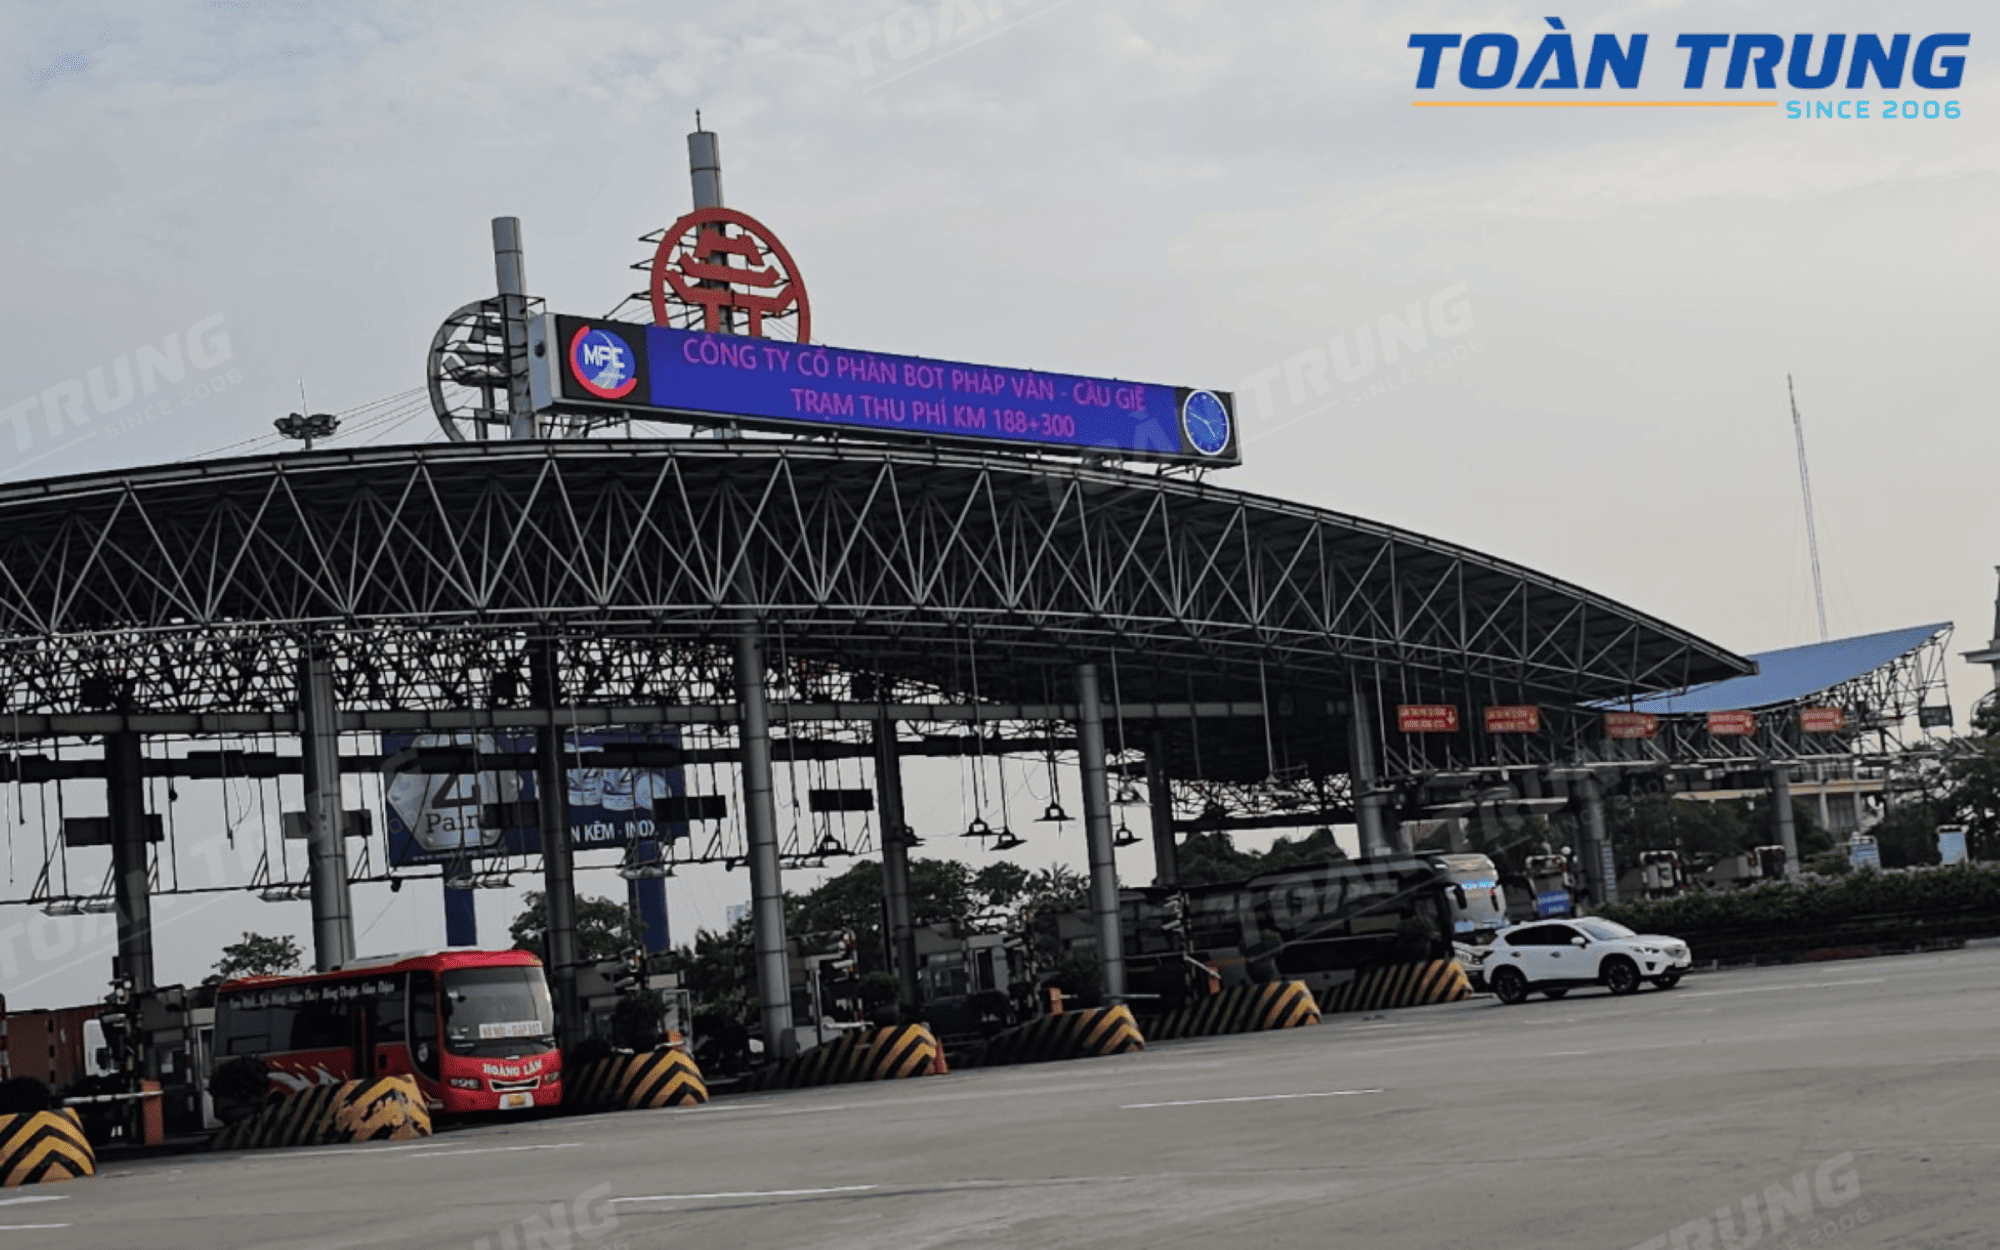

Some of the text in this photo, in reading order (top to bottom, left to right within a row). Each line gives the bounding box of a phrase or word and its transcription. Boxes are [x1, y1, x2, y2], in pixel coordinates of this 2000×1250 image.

[583, 343, 625, 368] MPC
[684, 333, 758, 371] CÔNG
[763, 347, 790, 372] TY
[904, 364, 944, 390] BOT
[790, 387, 1076, 438] TRẠM THU PHÍ KM 188+300
